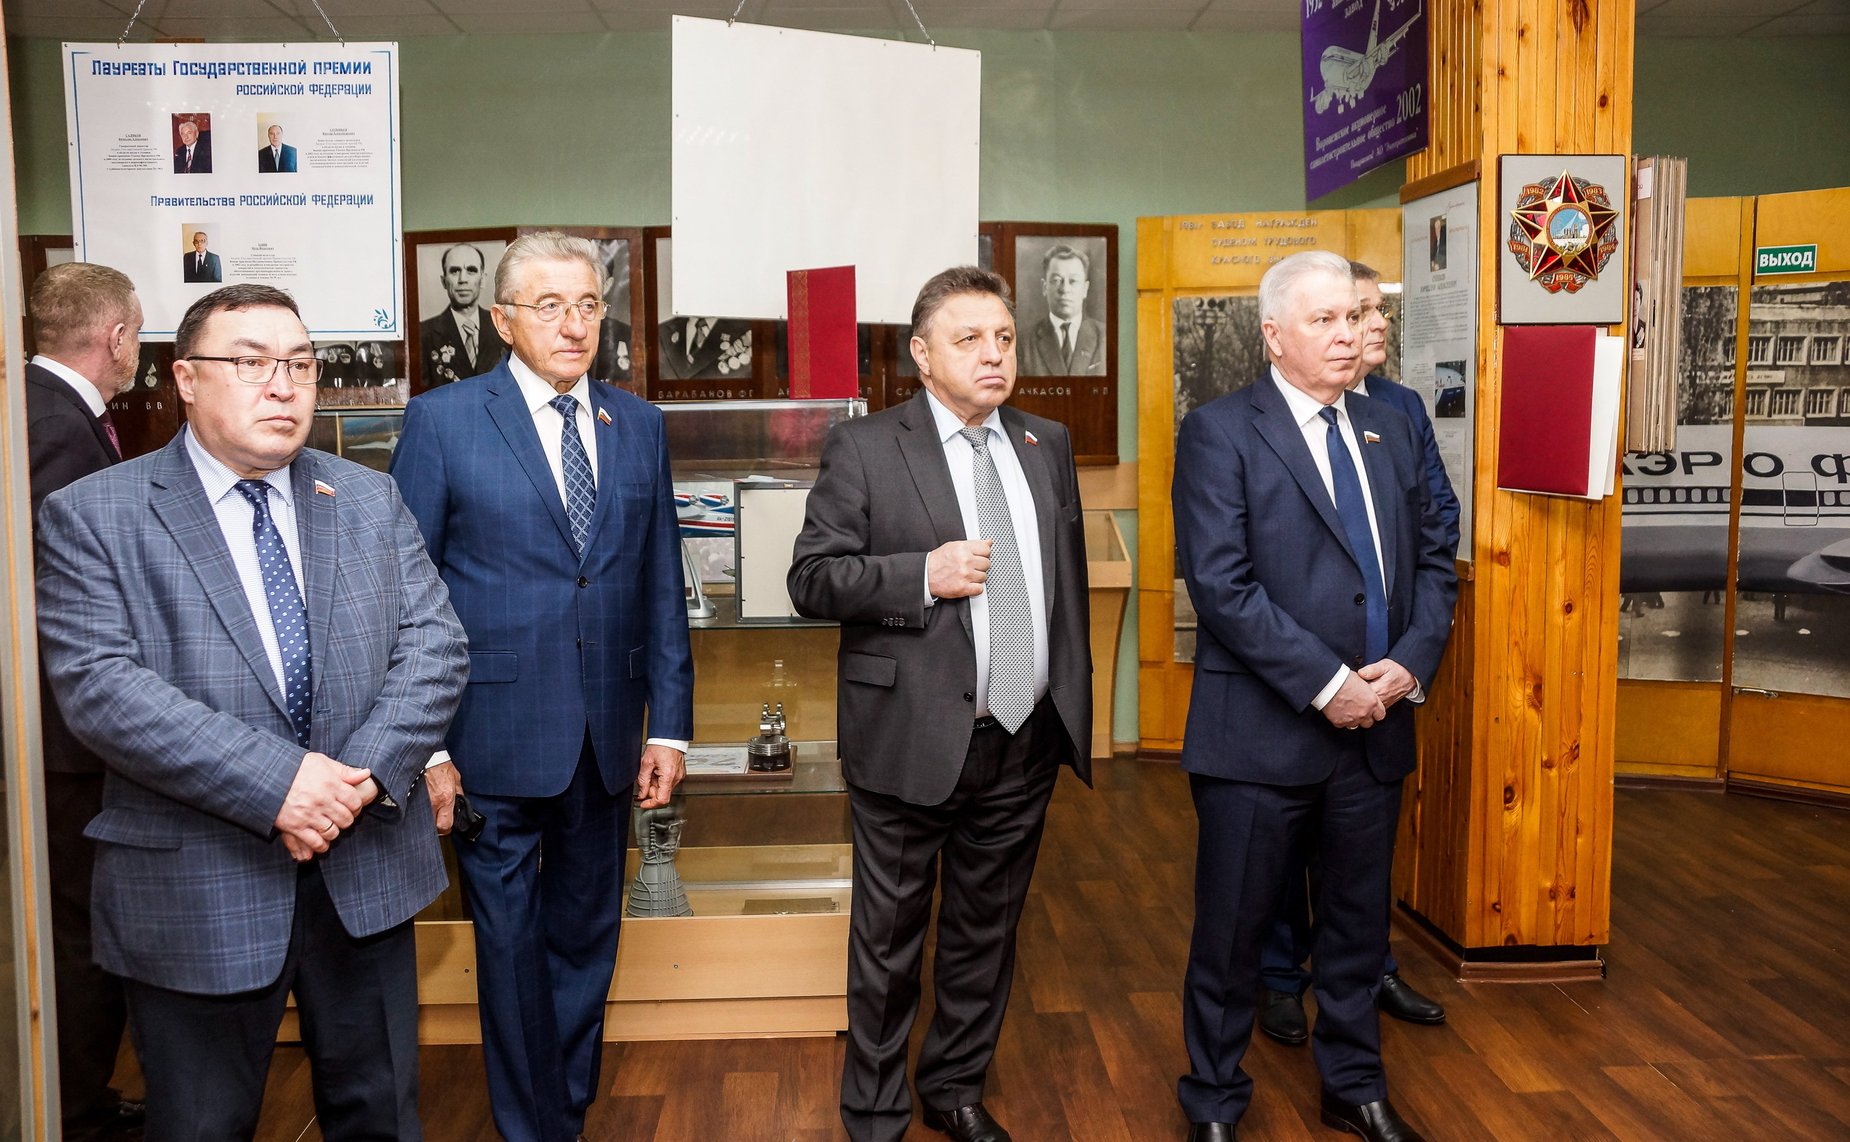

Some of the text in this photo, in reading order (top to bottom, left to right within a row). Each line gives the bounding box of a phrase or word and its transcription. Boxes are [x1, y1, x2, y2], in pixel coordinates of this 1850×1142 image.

[92, 60, 166, 75] Лауреаты
[173, 60, 307, 79] Государственной
[236, 82, 372, 98] РОССИЙСКОЙ ФЕДЕРАЦИИ
[1396, 83, 1421, 124] 2002
[150, 192, 374, 208] Правительства РОССИЙСКОЙ ФЕДЕРАЦИИ
[1760, 251, 1813, 268] ВЫХОД
[1555, 273, 1574, 281] 1985
[657, 389, 733, 399] БАРАБАНОВ
[1018, 386, 1072, 396] АЧКАСОВ
